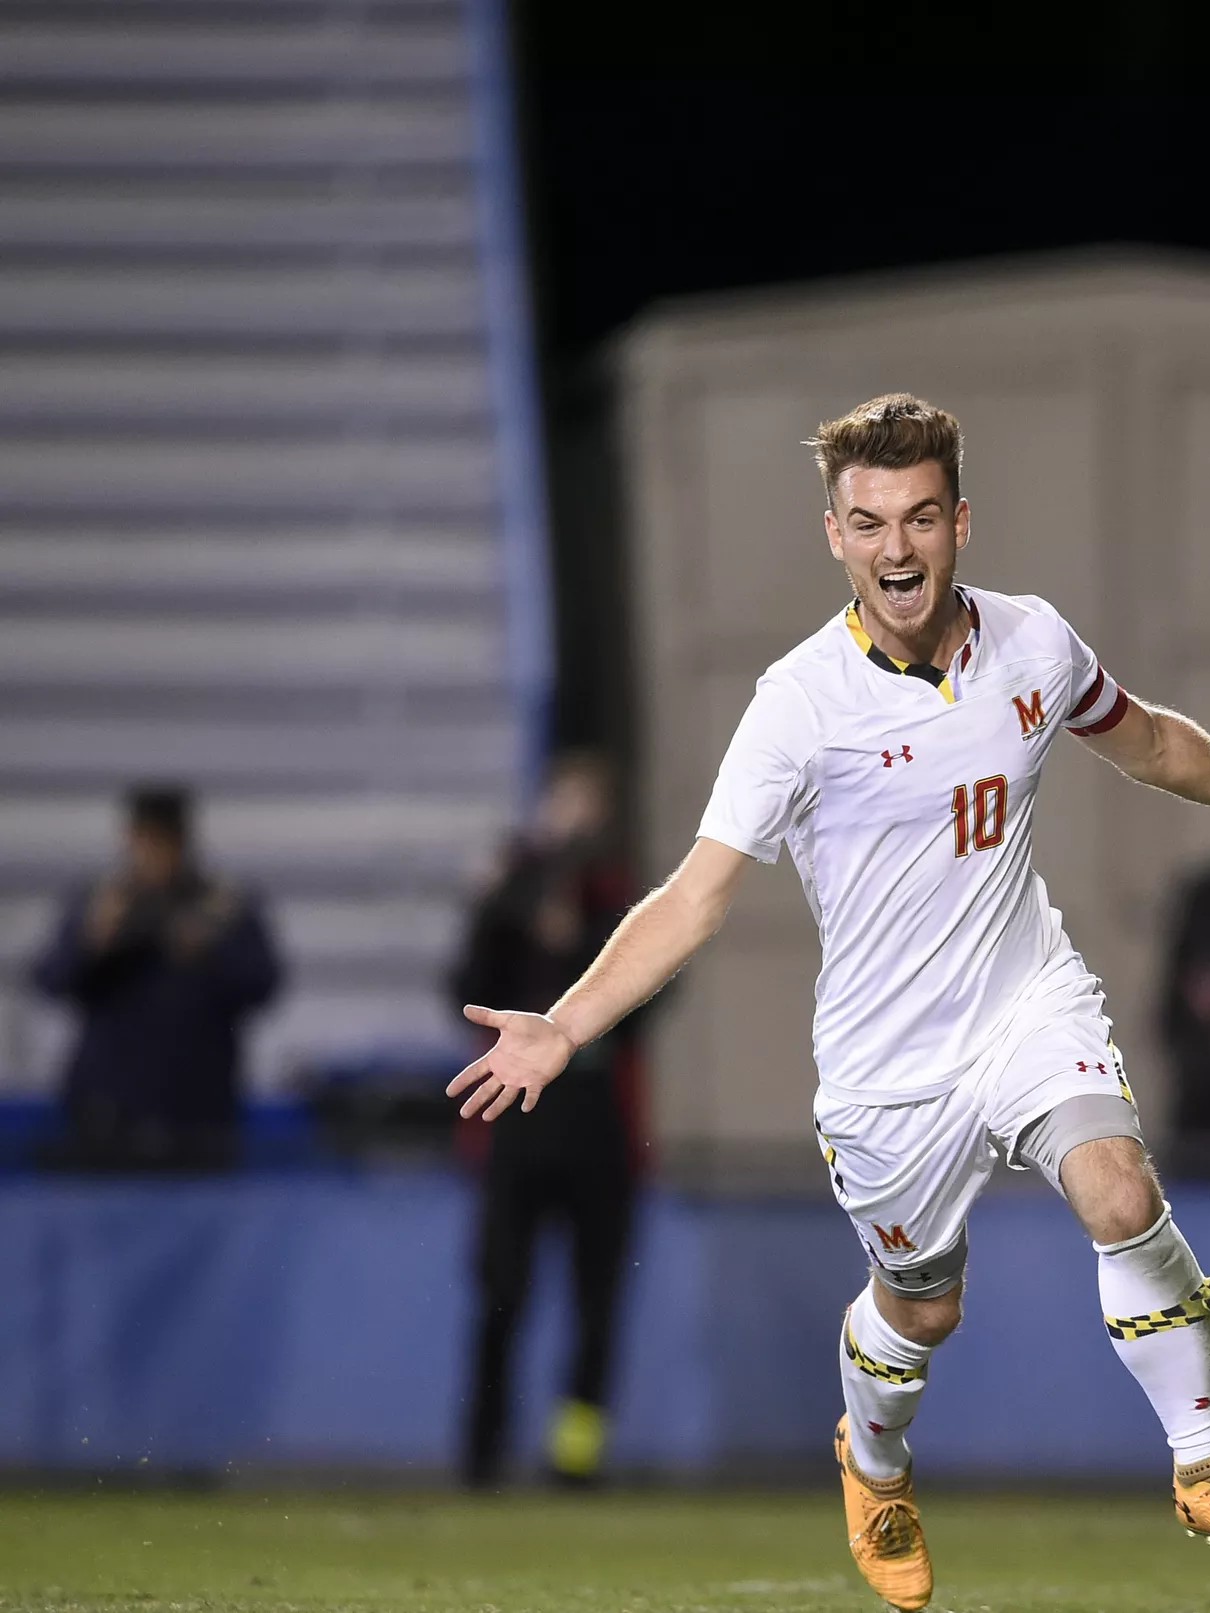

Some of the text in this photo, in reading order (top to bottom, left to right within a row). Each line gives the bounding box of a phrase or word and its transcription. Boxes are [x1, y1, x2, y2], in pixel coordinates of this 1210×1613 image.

[1012, 689, 1047, 739] M
[950, 774, 1009, 858] 10
[871, 1222, 918, 1254] M
